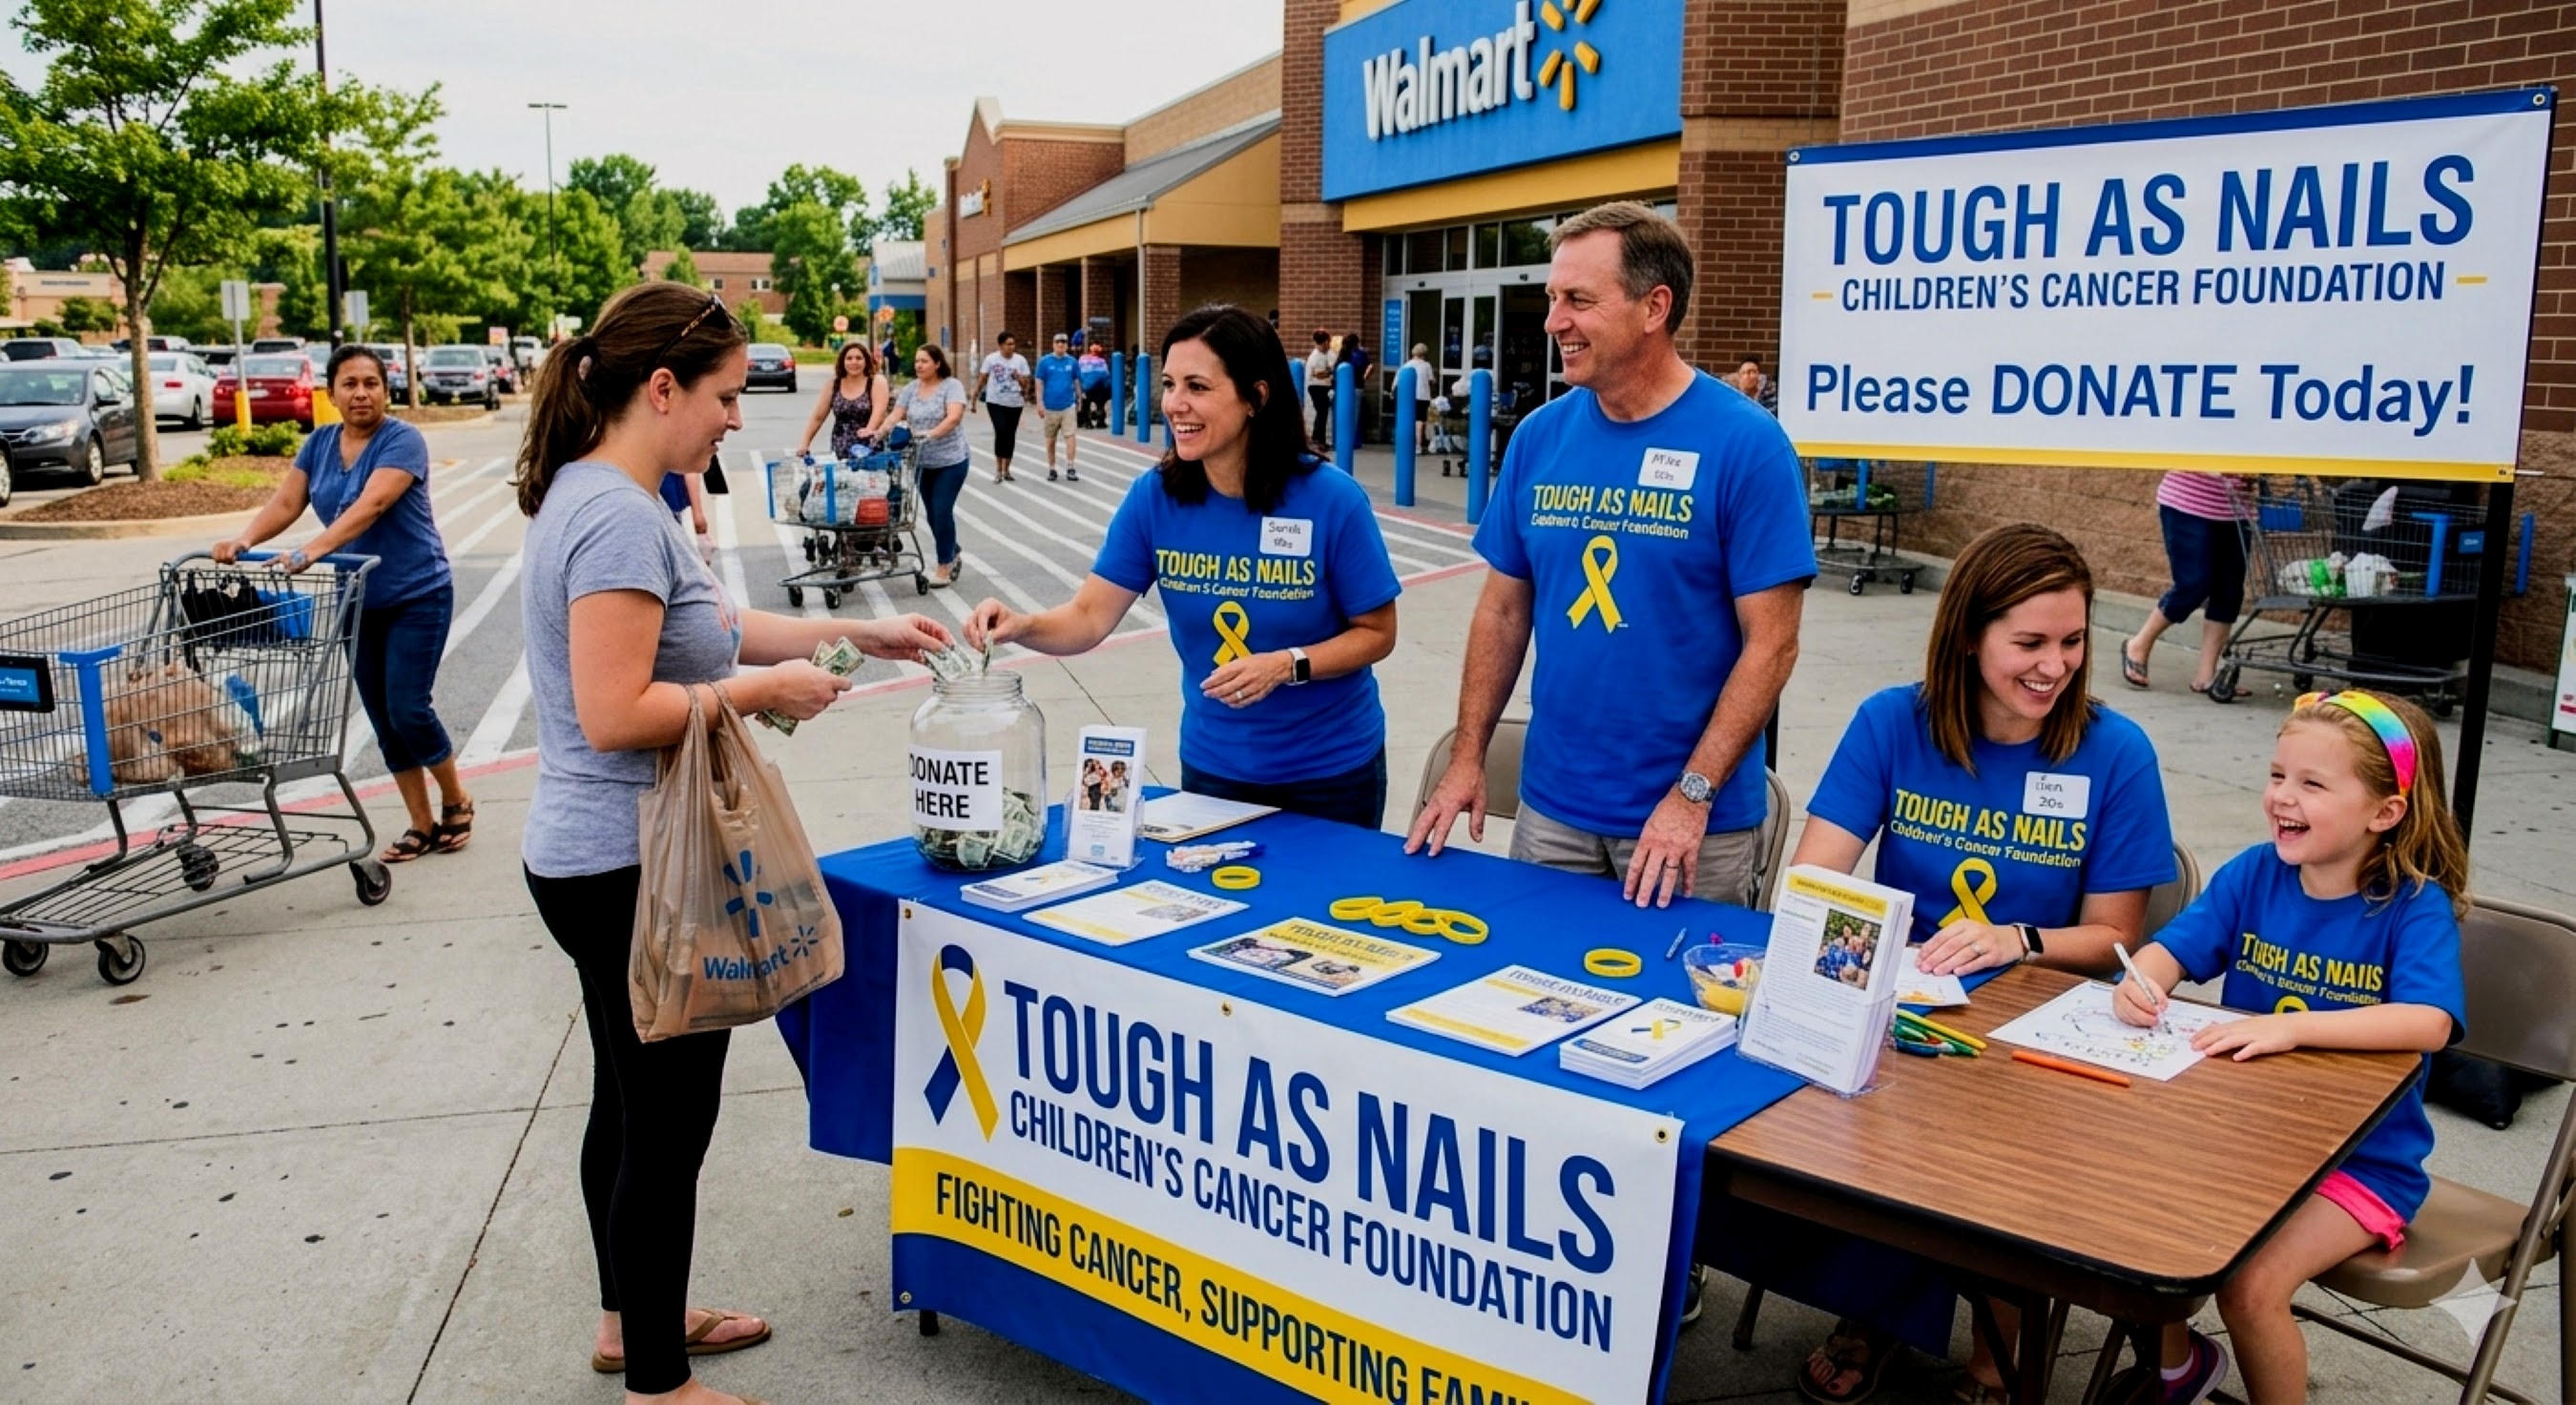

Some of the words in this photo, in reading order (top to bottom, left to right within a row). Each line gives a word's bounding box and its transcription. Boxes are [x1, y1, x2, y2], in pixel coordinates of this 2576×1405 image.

[1363, 0, 1535, 141] Walmart
[1823, 181, 2061, 266] TOUGH
[2085, 173, 2186, 257] AS
[2217, 154, 2474, 253] NAILS
[1842, 273, 2029, 312] CHILDREN'S
[2042, 269, 2179, 308] CANCER
[2192, 260, 2445, 305] FOUNDATION
[1808, 363, 1970, 415] Please
[1991, 364, 2238, 420] DONATE
[2259, 364, 2474, 438] Today!
[1533, 485, 1595, 512] TOUGH
[1597, 487, 1625, 515] AS
[1629, 489, 1694, 523] NAILS
[1155, 549, 1221, 580] TOUGH
[1225, 556, 1251, 583] AS
[1256, 559, 1316, 586] NAILS
[916, 788, 970, 819] HERE
[1894, 788, 1971, 833] TOUGH
[1973, 809, 2008, 839] AS
[2012, 814, 2088, 851] NAILS
[2292, 952, 2321, 981] AS
[1004, 980, 1214, 1146] TOUGH
[1236, 1055, 1331, 1184] AS
[1358, 1090, 1615, 1274] NAILS
[1010, 1089, 1184, 1199] CHILDREN'S
[1194, 1157, 1331, 1258] CANCER
[1343, 1209, 1612, 1353] FOUNDATION
[937, 1171, 1062, 1259] FIGHTING
[1070, 1223, 1191, 1322] CANCER,
[1200, 1278, 1407, 1405] SUPPORTING
